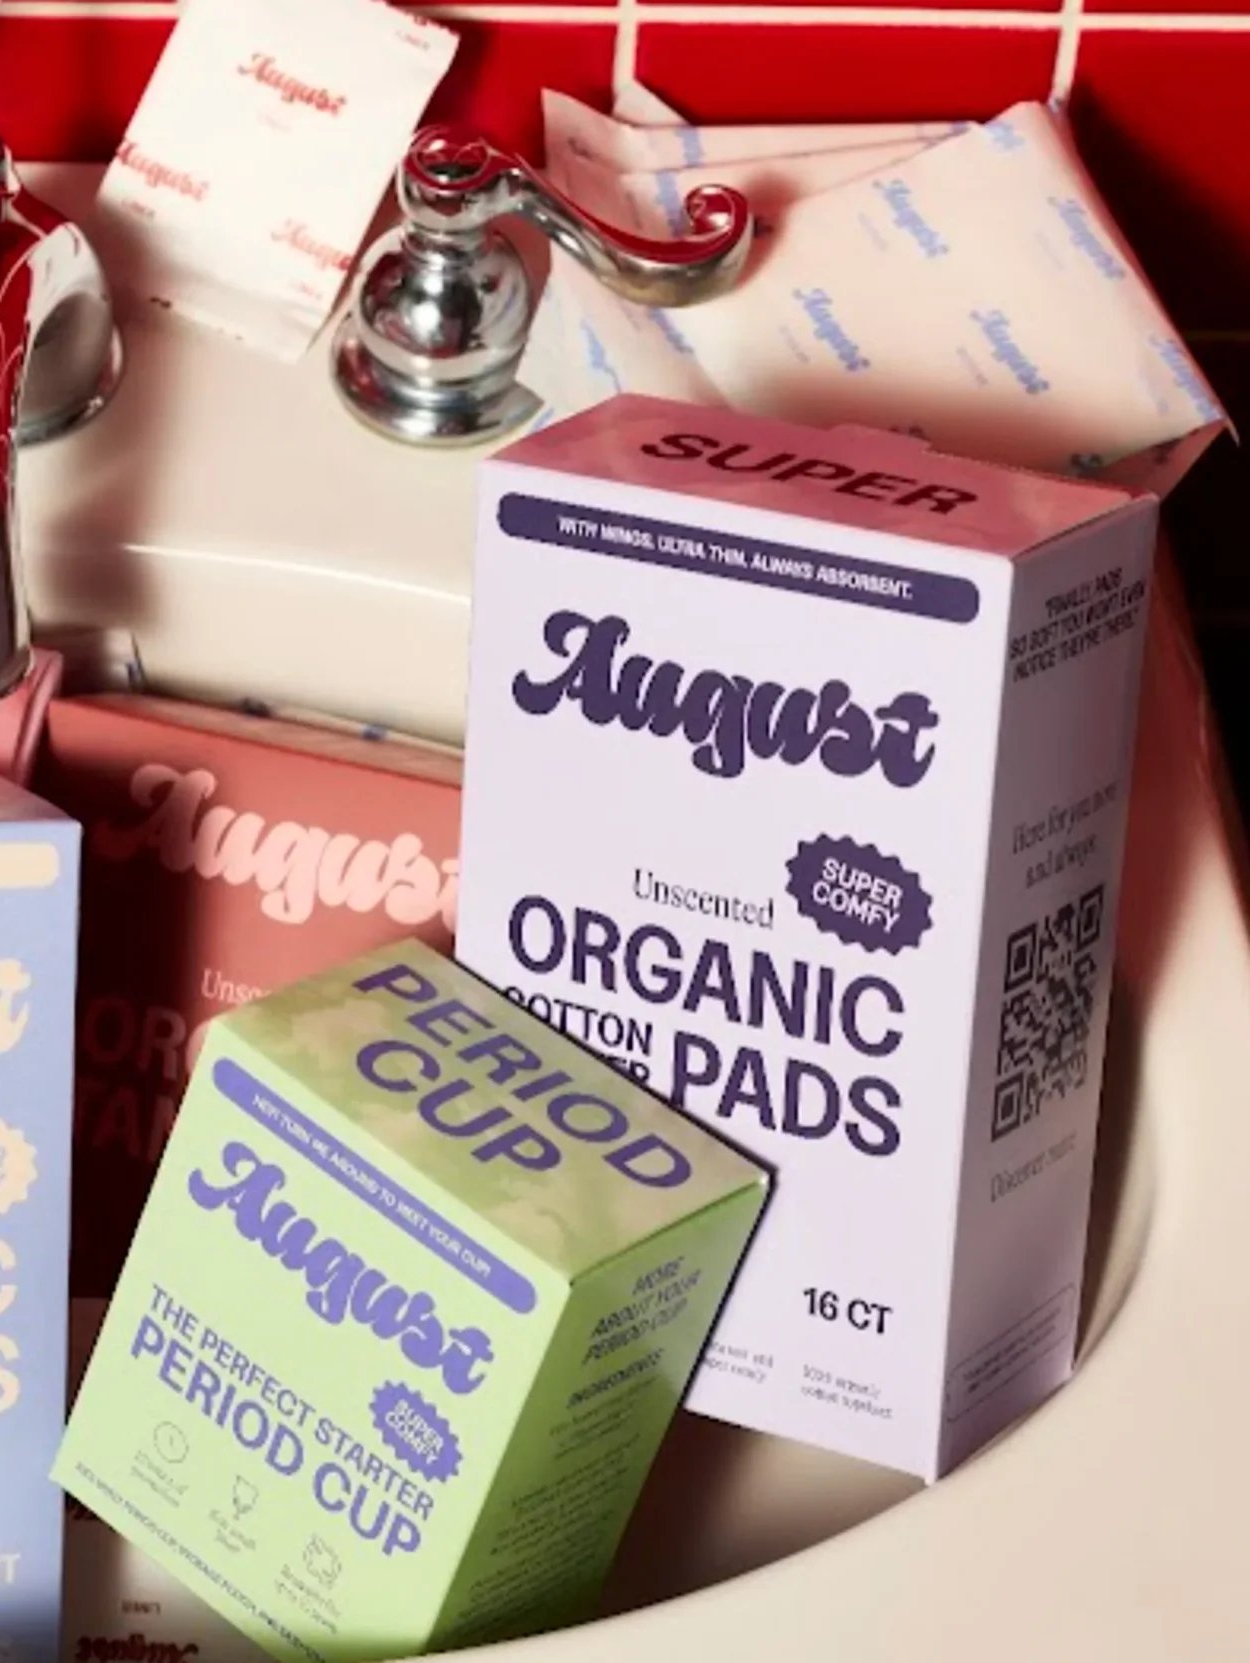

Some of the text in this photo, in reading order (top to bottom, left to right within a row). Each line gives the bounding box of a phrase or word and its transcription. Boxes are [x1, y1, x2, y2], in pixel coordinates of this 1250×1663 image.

[236, 52, 348, 119] August
[639, 431, 979, 515] SUPER
[558, 516, 599, 538] WITH
[511, 609, 939, 789] August
[634, 867, 776, 930] Unscented
[812, 881, 902, 934] COMFY
[821, 855, 903, 908] SUPER
[508, 894, 905, 1059] ORGANIC
[351, 963, 693, 1190] PERIOD
[354, 1039, 562, 1173] CUP
[669, 1029, 903, 1158] PADS
[380, 1185, 398, 1207] TO
[187, 1140, 495, 1396] August
[802, 1286, 894, 1335] 16 CT
[130, 1315, 305, 1480] PERIOD
[312, 1462, 423, 1558] CUP
[149, 1282, 201, 1335] THE
[199, 1331, 316, 1428] PERFECT
[313, 1415, 436, 1521] STARTER
[384, 1410, 439, 1465] COMFY
[394, 1398, 444, 1452] SUPER
